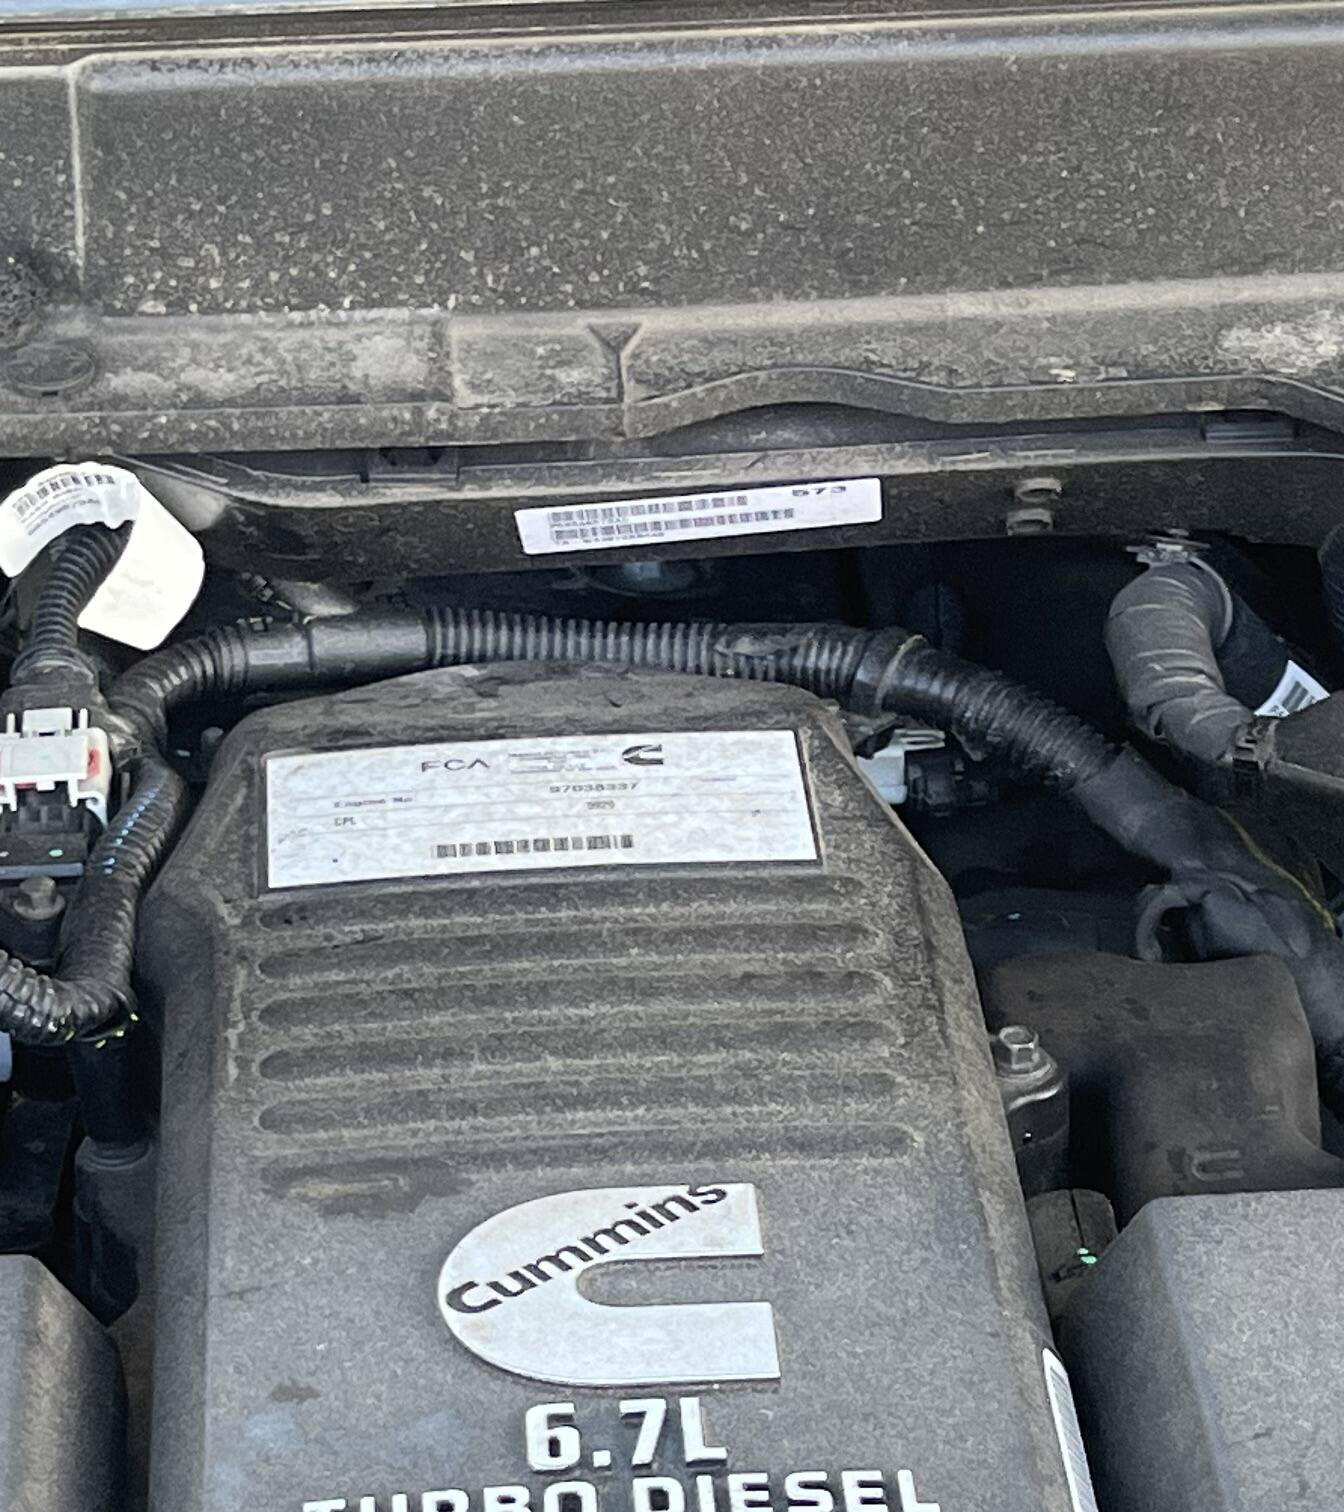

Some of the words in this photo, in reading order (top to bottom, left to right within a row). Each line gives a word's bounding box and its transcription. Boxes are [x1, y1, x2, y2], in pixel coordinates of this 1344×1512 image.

[421, 757, 491, 773] FCA
[445, 1184, 728, 1315] Cummins
[524, 1396, 729, 1472] 6.7L
